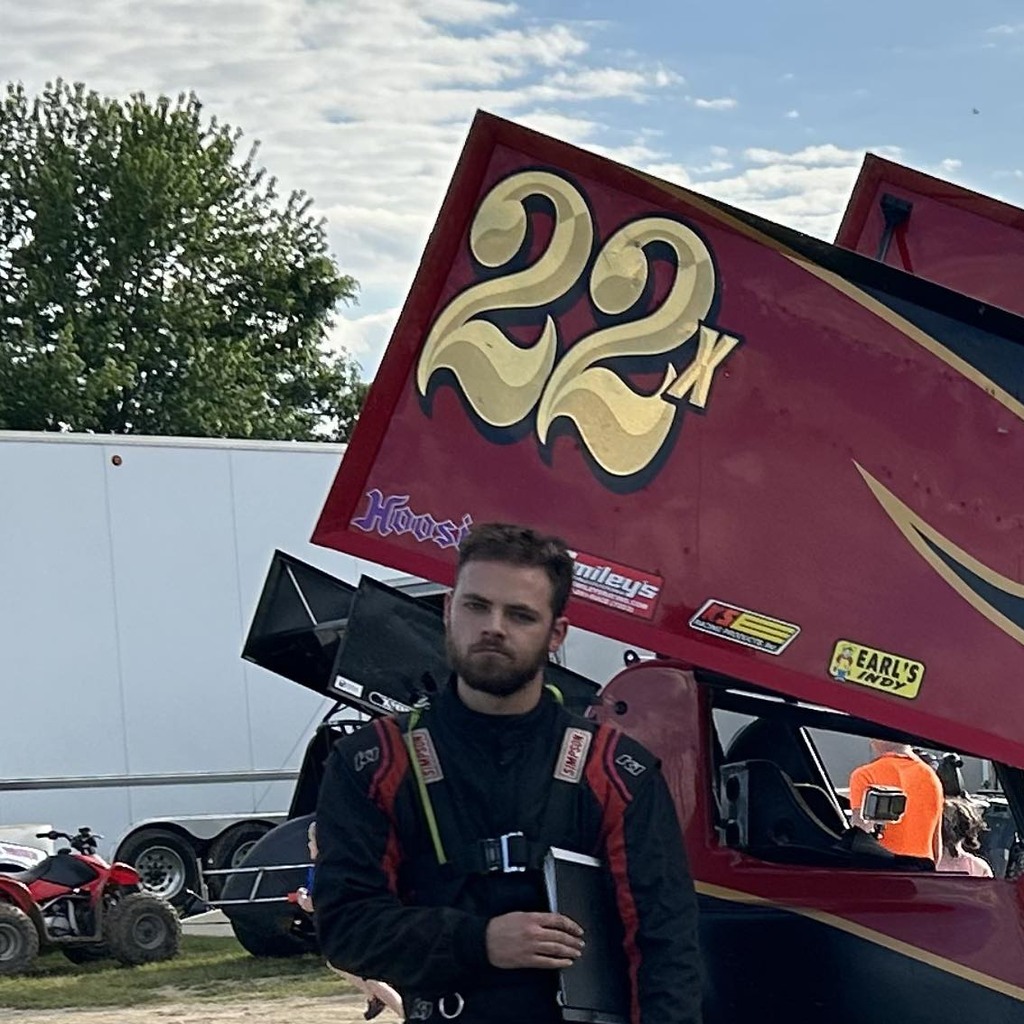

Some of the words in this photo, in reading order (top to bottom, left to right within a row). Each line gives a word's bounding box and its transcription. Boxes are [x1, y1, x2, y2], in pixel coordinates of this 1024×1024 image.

[856, 649, 919, 683] EARL'S
[857, 671, 906, 690] INDY
[562, 732, 585, 777] SIMPSON
